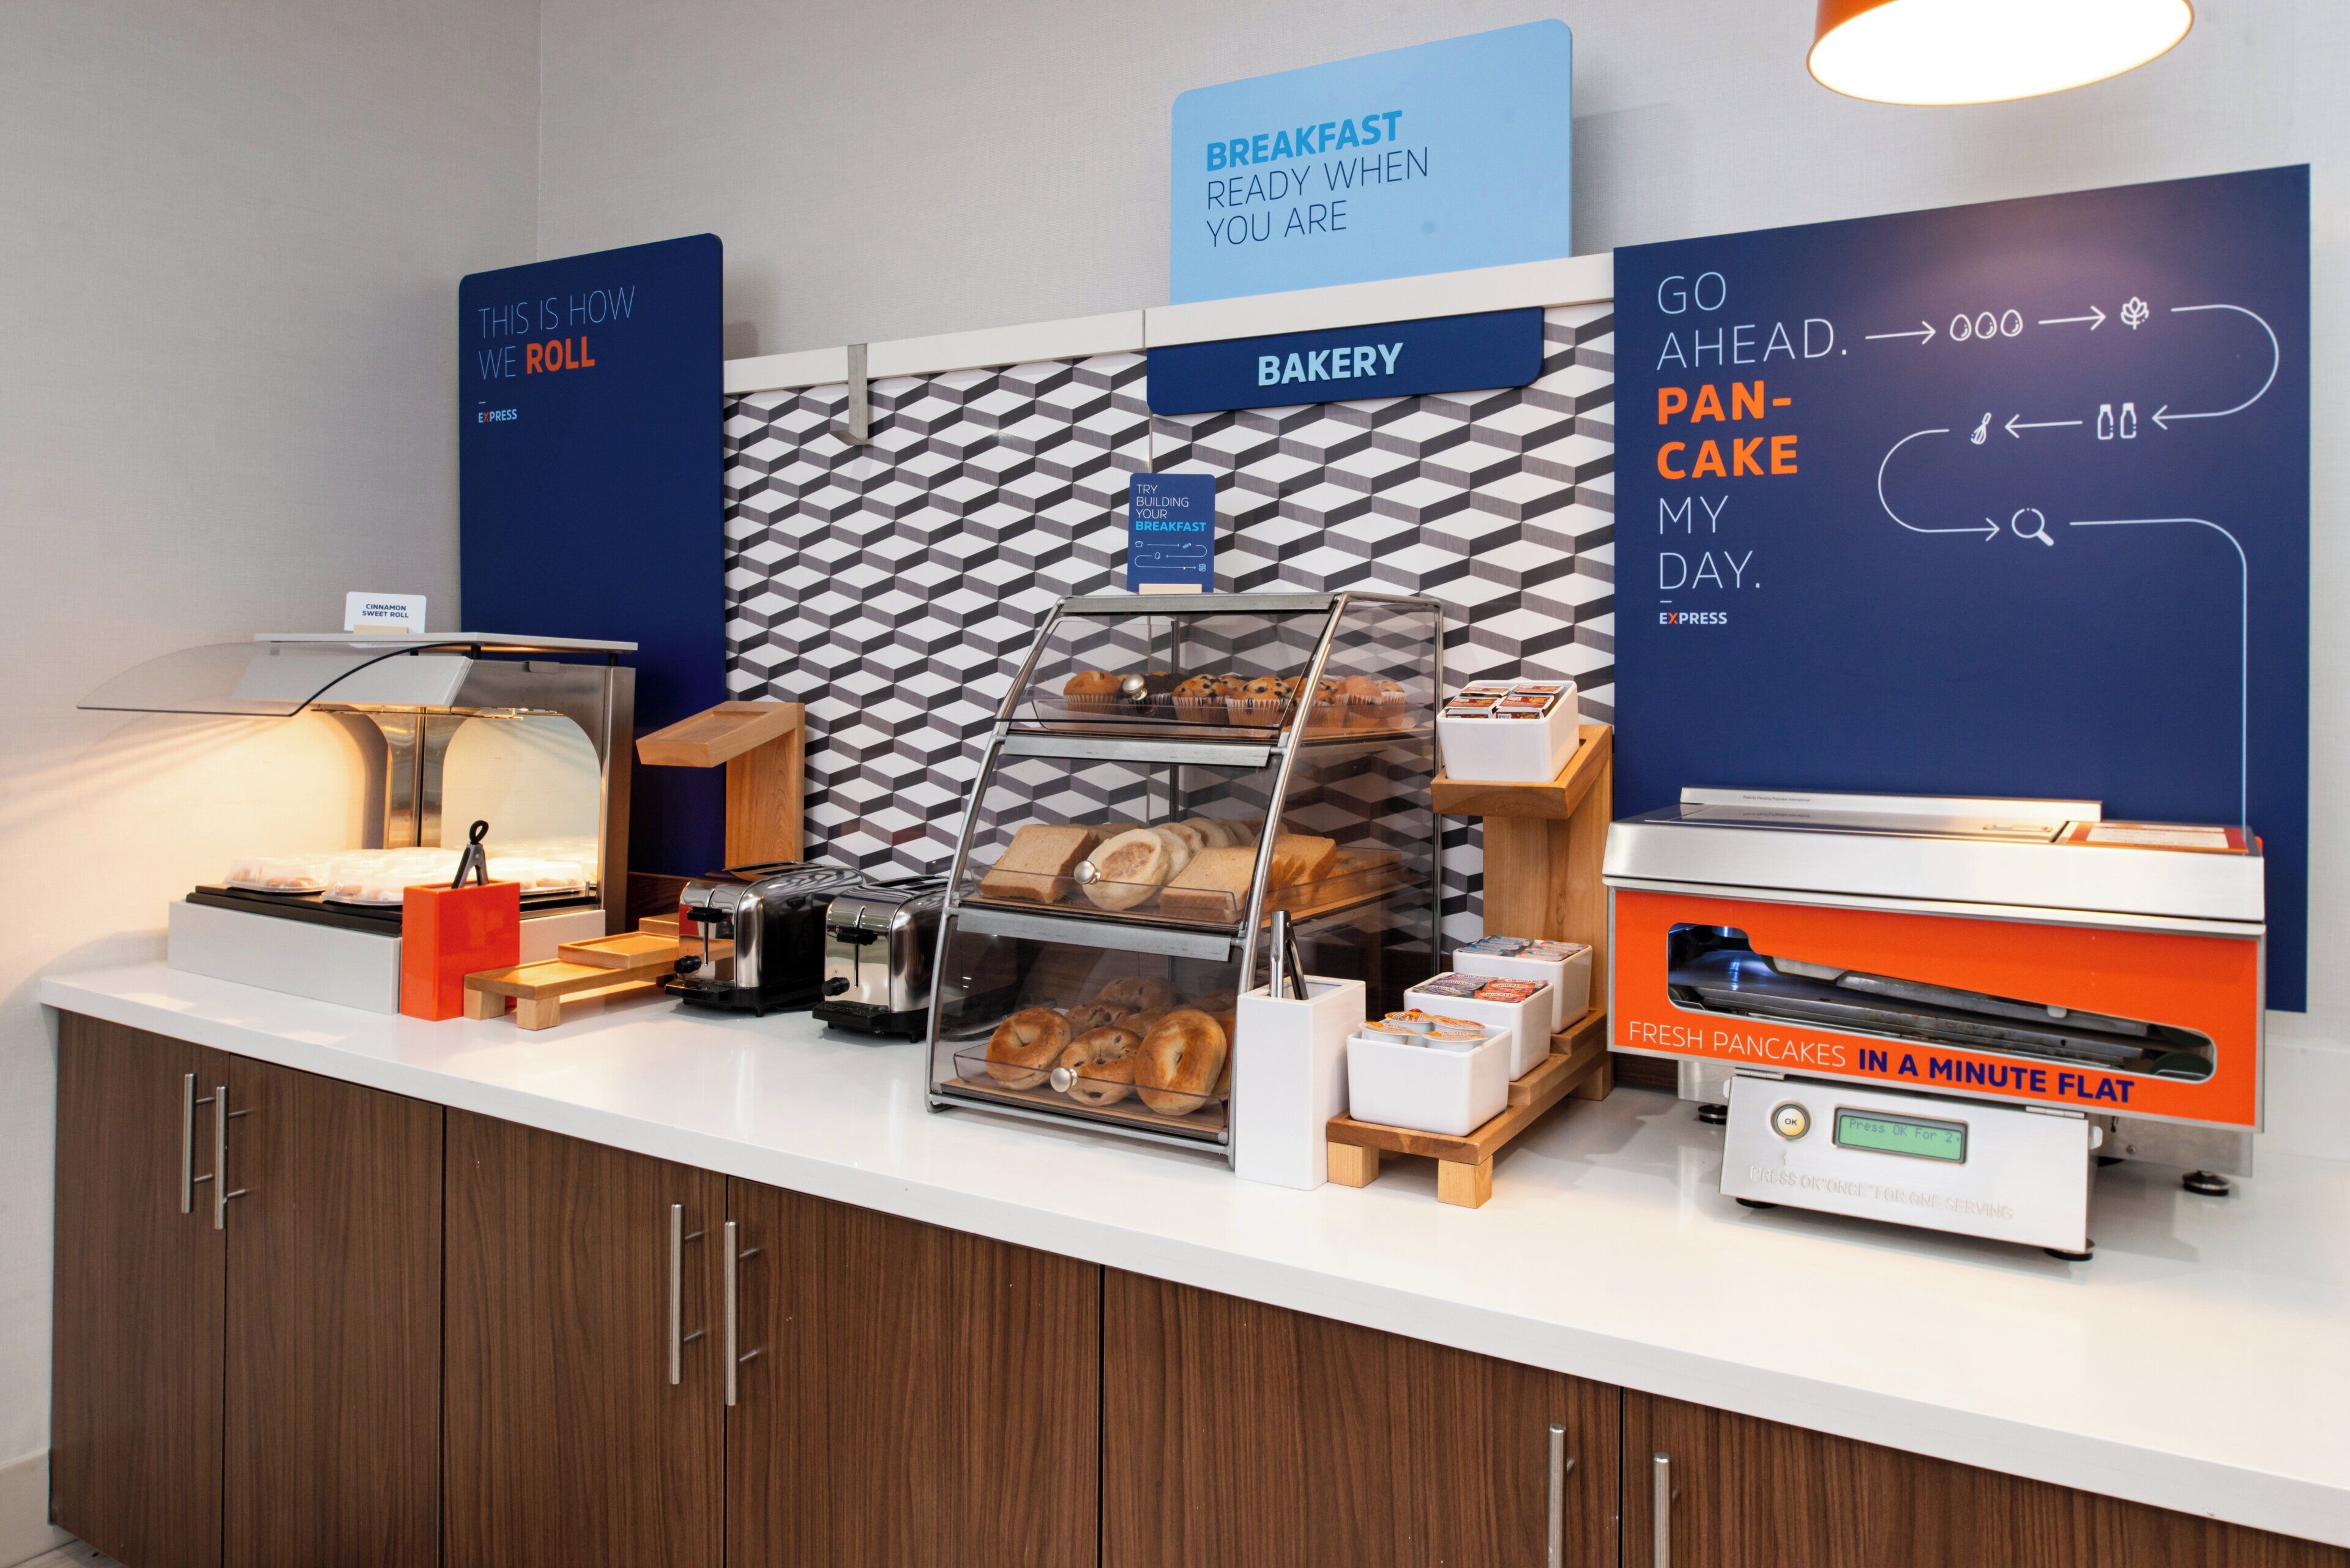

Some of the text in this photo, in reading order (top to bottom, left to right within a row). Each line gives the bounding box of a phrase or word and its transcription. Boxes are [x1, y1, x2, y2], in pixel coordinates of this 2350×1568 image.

[1207, 110, 1403, 172] BREAKFAST
[1207, 146, 1428, 210] READY WHEN
[1206, 200, 1347, 247] YOU ARE
[478, 285, 635, 338] THIS IS HOW
[1658, 271, 1726, 315] GO
[479, 335, 596, 380] WE ROLL
[1258, 342, 1404, 387] BAKERY
[1656, 318, 1847, 370] AHEAD.
[478, 409, 518, 424] EXPRESS
[1658, 380, 1792, 425] PAN-
[1657, 435, 1798, 480] CAKE
[1136, 484, 1158, 495] TRY
[1136, 496, 1189, 507] BUILDING
[1135, 509, 1168, 519] YOUR
[1135, 521, 1207, 532] BREAKFAST
[1660, 495, 1729, 535] MY
[1660, 550, 1761, 589] DAY.
[1659, 611, 1728, 625] EXPRESS
[1629, 1021, 2135, 1103] FRESH PANCAKES IN A MINUTE FLAT
[1785, 1118, 1797, 1126] OK
[1849, 1118, 1885, 1133] Press
[1893, 1125, 1908, 1137] OK
[1914, 1127, 1938, 1141] For
[1750, 1165, 1797, 1187] PRESS
[1875, 1185, 1905, 1203] FOR
[1909, 1191, 1941, 1208] ONE
[1944, 1196, 2014, 1220] SERVING
